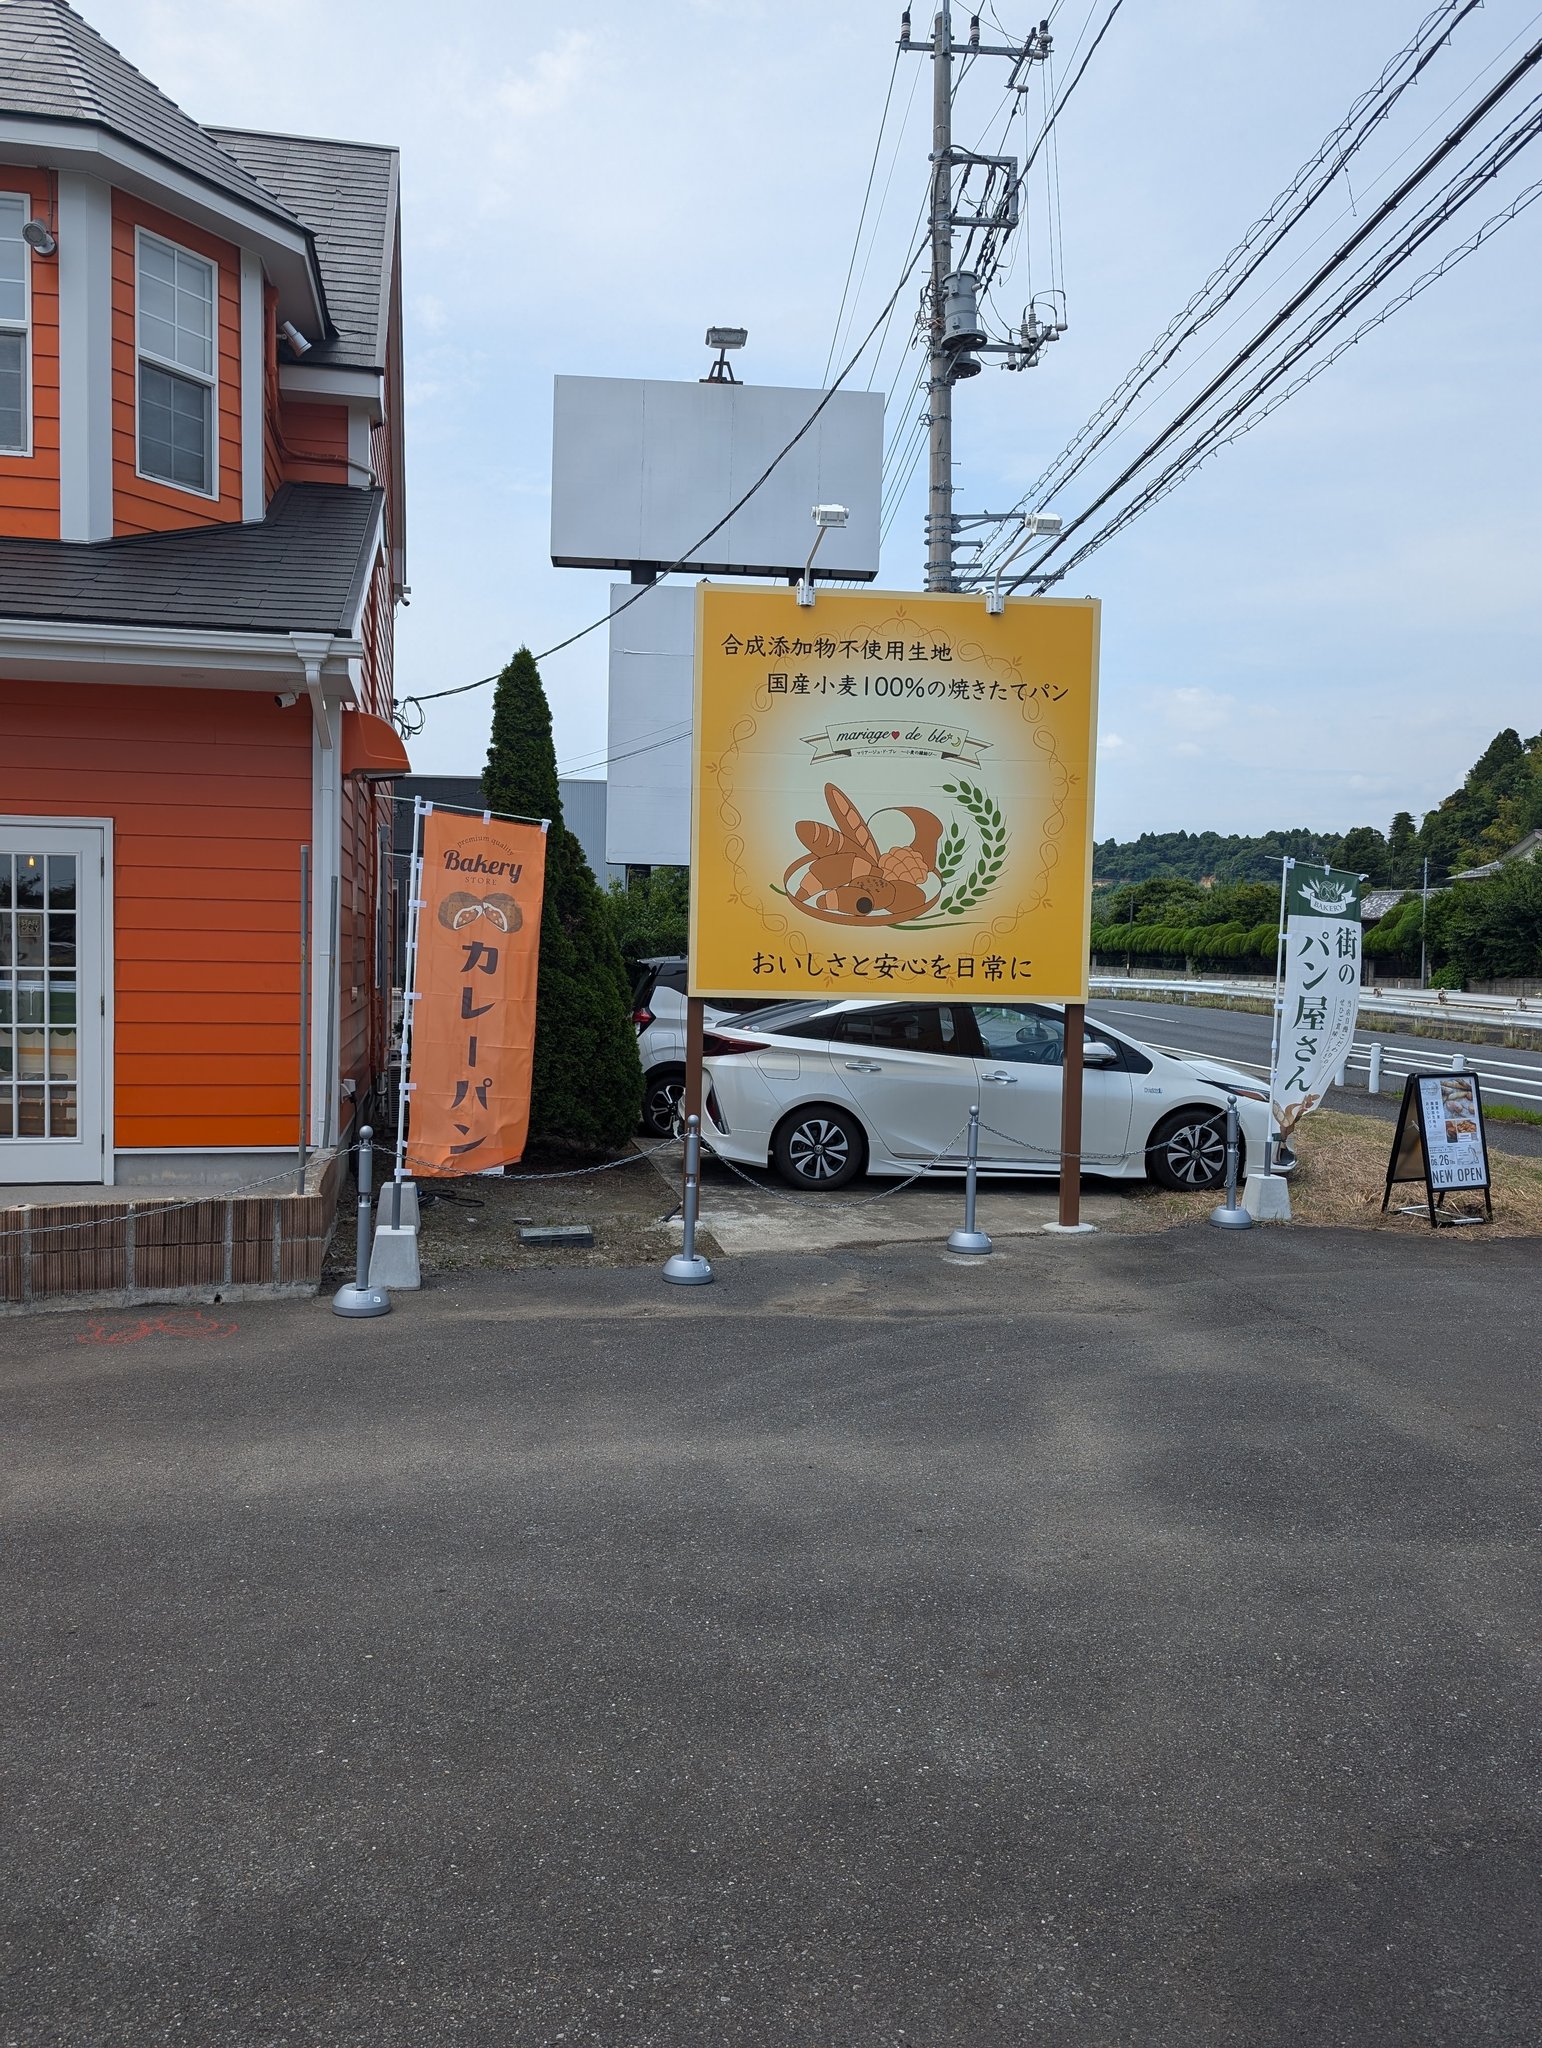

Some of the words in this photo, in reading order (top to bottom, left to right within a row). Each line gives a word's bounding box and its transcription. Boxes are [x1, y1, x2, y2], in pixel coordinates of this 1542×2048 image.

[720, 633, 953, 663] 合成添加物不使用生地
[767, 672, 1069, 702] 国産小麦100%の焼きたてパン
[836, 728, 890, 744] mariage
[905, 727, 922, 741] de
[457, 836, 490, 848] premium
[491, 838, 514, 856] quality
[443, 849, 523, 884] Bakery
[465, 876, 497, 886] STORE
[1313, 901, 1343, 911] BAKERY
[752, 951, 1032, 982] おいしさと安心を日常に
[1335, 926, 1358, 985] 街の
[1284, 931, 1329, 1092] パン屋さん
[450, 941, 499, 1154] カレーパン
[1439, 1154, 1450, 1166] 26
[1432, 1169, 1453, 1184] NEW
[1457, 1167, 1483, 1182] OPEN
